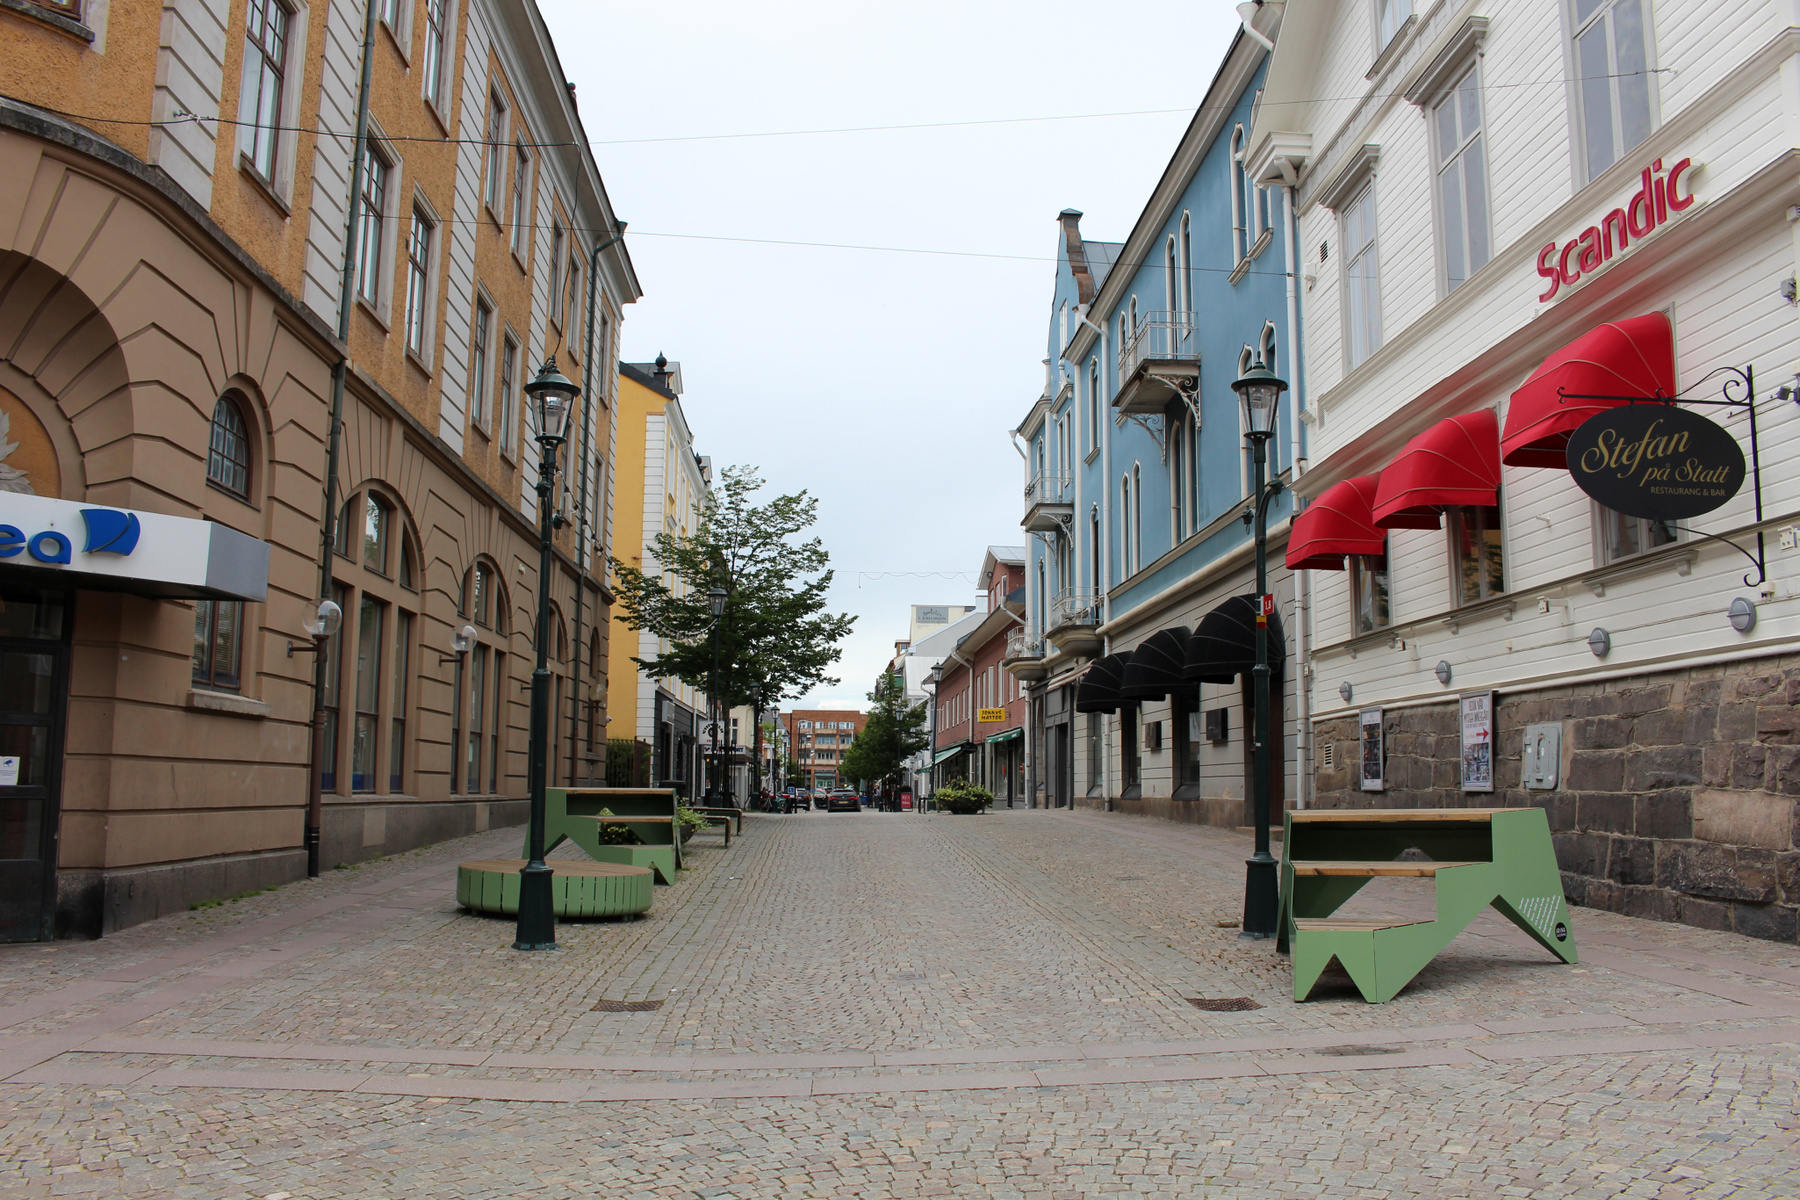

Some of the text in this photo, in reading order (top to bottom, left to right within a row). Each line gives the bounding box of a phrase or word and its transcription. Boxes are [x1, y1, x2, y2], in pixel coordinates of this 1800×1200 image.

[1537, 157, 1695, 303] Scandic
[1581, 418, 1691, 479] Stefan
[1639, 457, 1730, 487] på Statt
[1650, 486, 1726, 496] RESTAURANG & BAR
